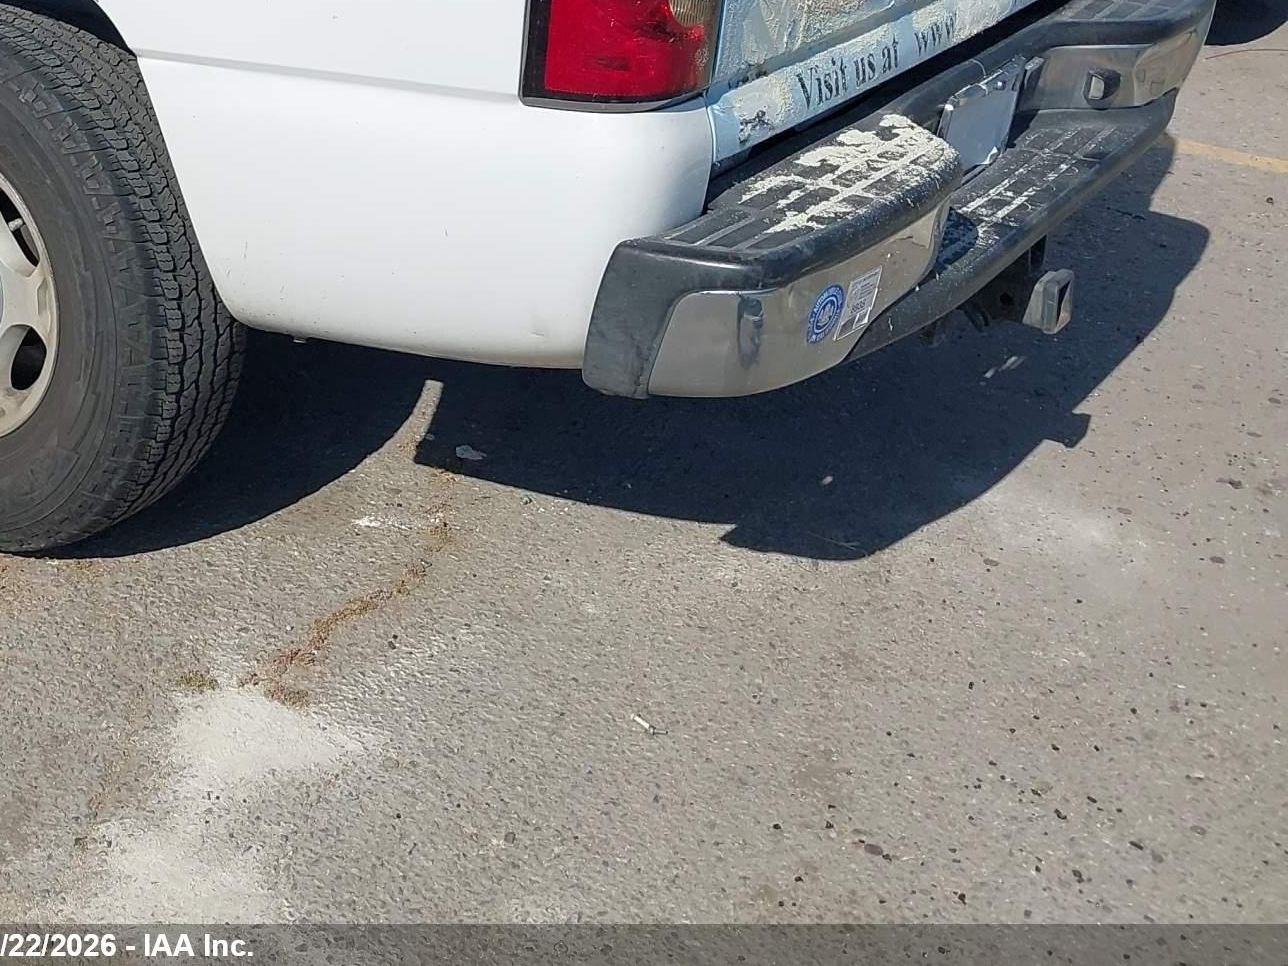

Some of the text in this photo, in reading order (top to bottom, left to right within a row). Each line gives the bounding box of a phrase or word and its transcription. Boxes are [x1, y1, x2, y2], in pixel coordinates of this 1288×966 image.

[795, 56, 848, 110] Visit
[853, 52, 877, 88] us
[881, 33, 899, 75] at
